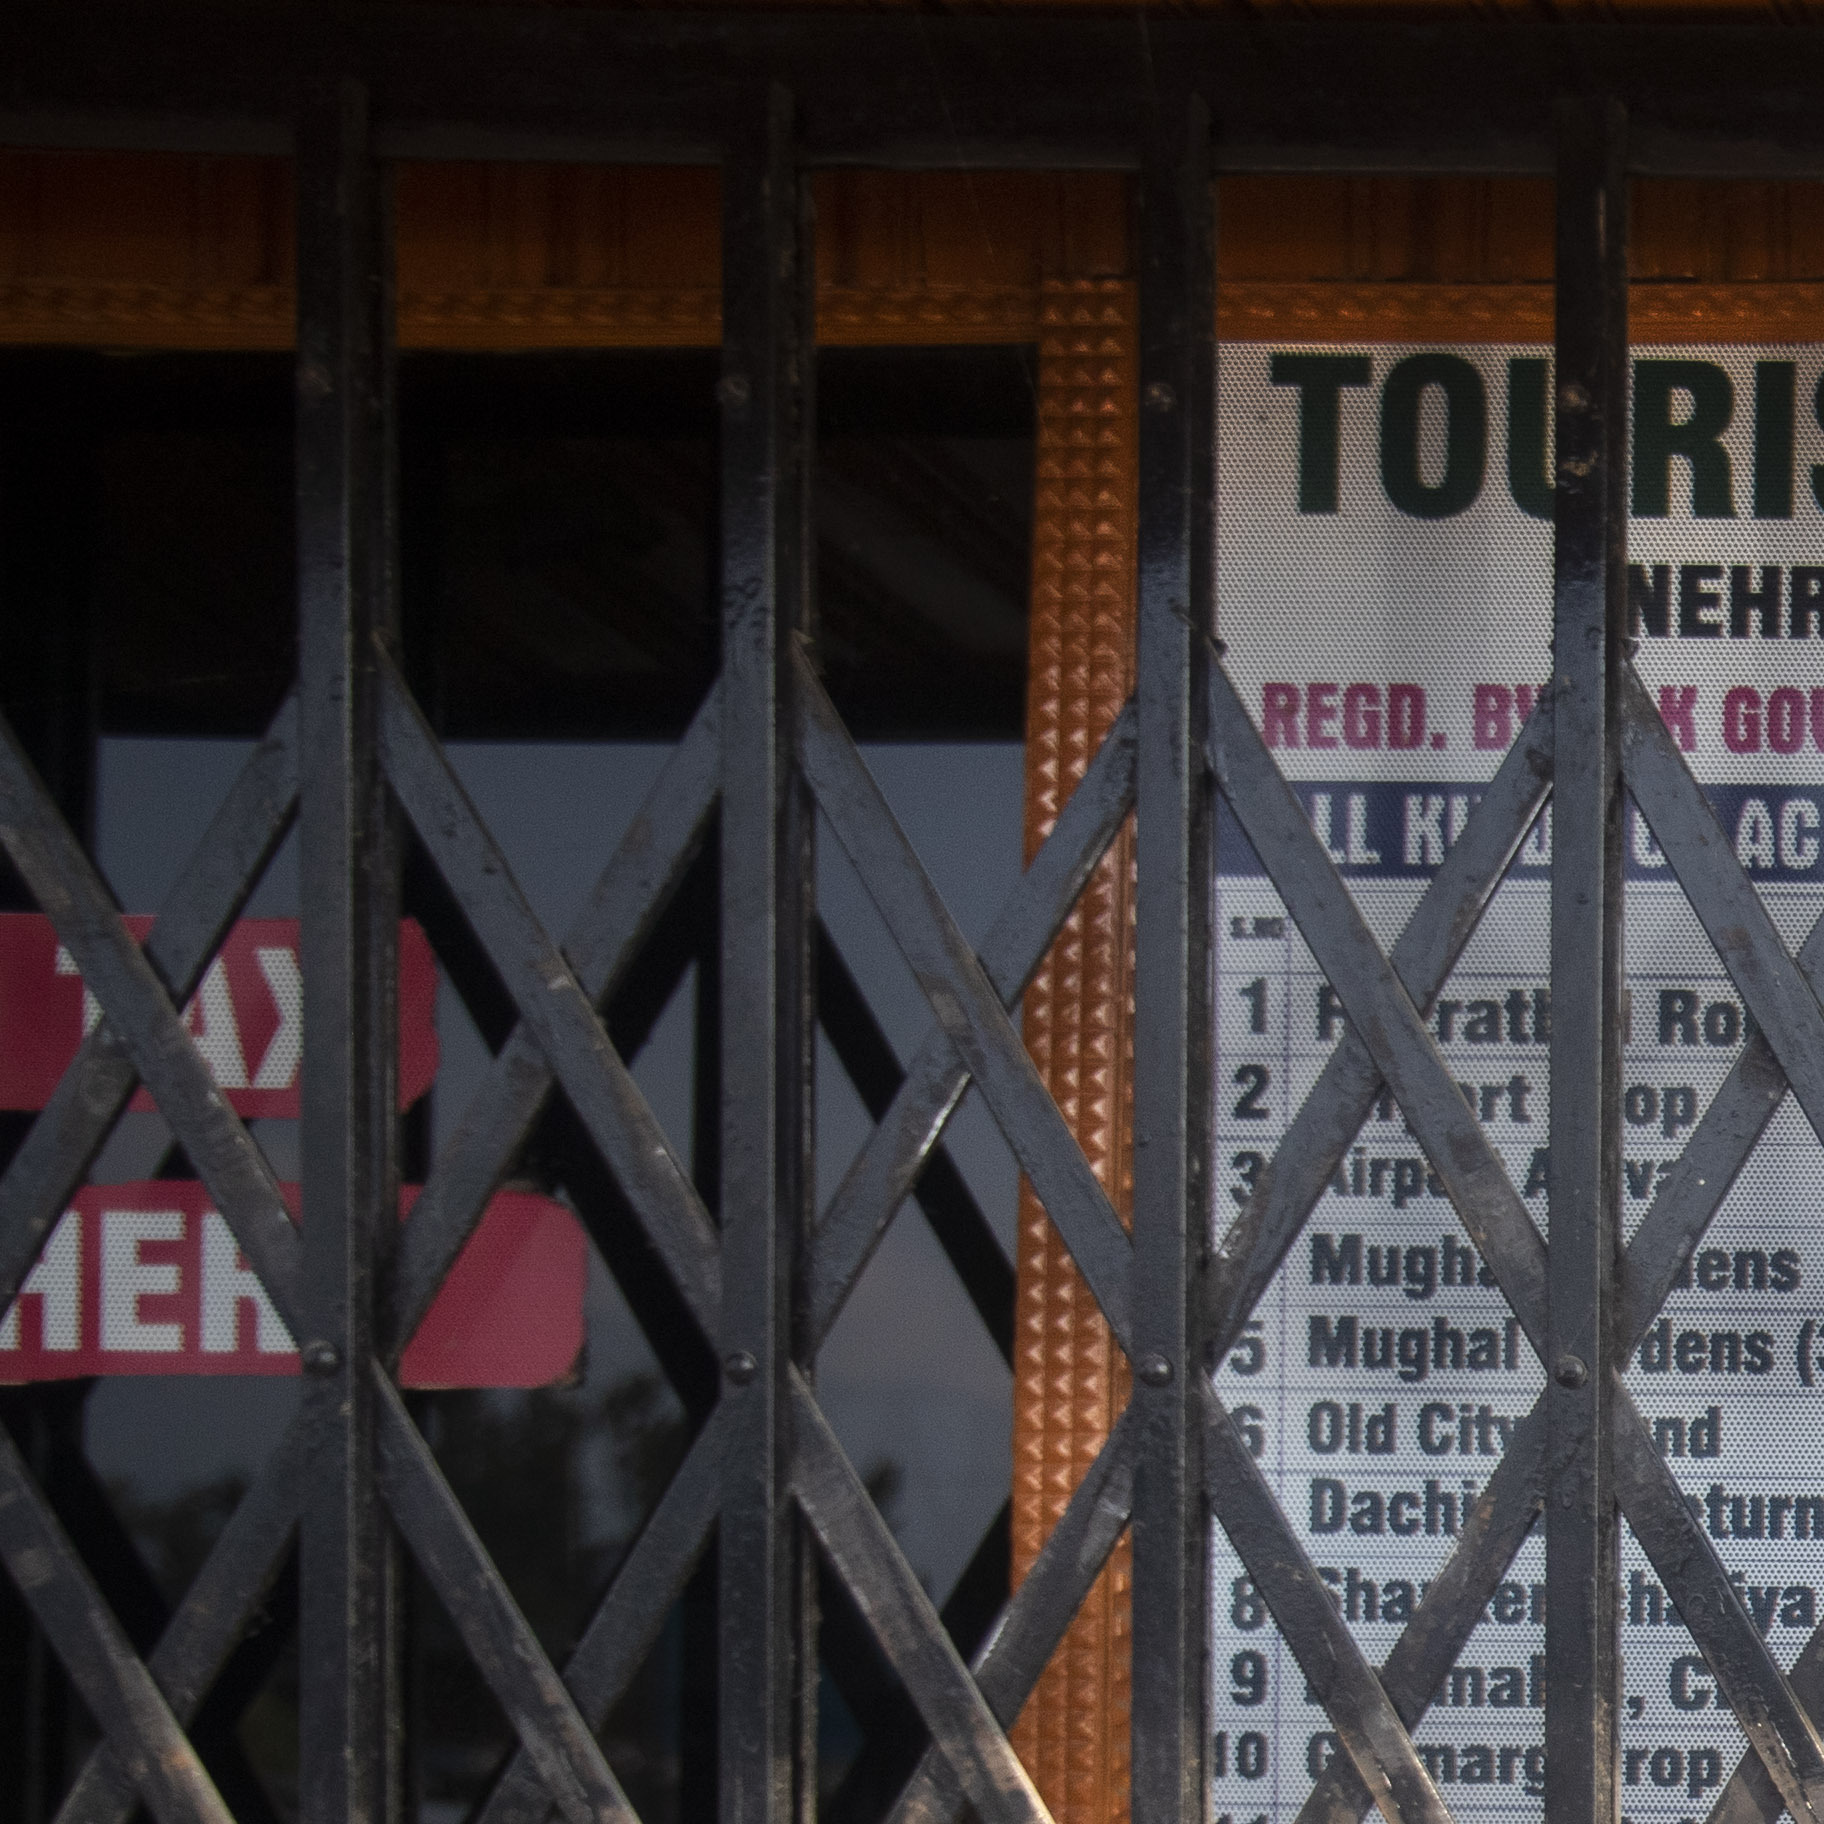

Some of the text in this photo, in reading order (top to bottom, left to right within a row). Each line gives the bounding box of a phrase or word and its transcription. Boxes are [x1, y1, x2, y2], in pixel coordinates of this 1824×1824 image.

[1263, 682, 1447, 752] REGD.
[1312, 793, 1382, 866] LL
[1735, 798, 1822, 871] AC
[1239, 979, 1269, 1034] 1
[1232, 1064, 1271, 1120] 2
[1309, 1232, 1503, 1300] Mugh
[1308, 1314, 1519, 1383] Mughal
[1306, 1399, 1398, 1456] Old
[1230, 1650, 1268, 1707] 9
[1624, 1747, 1724, 1801] rop
